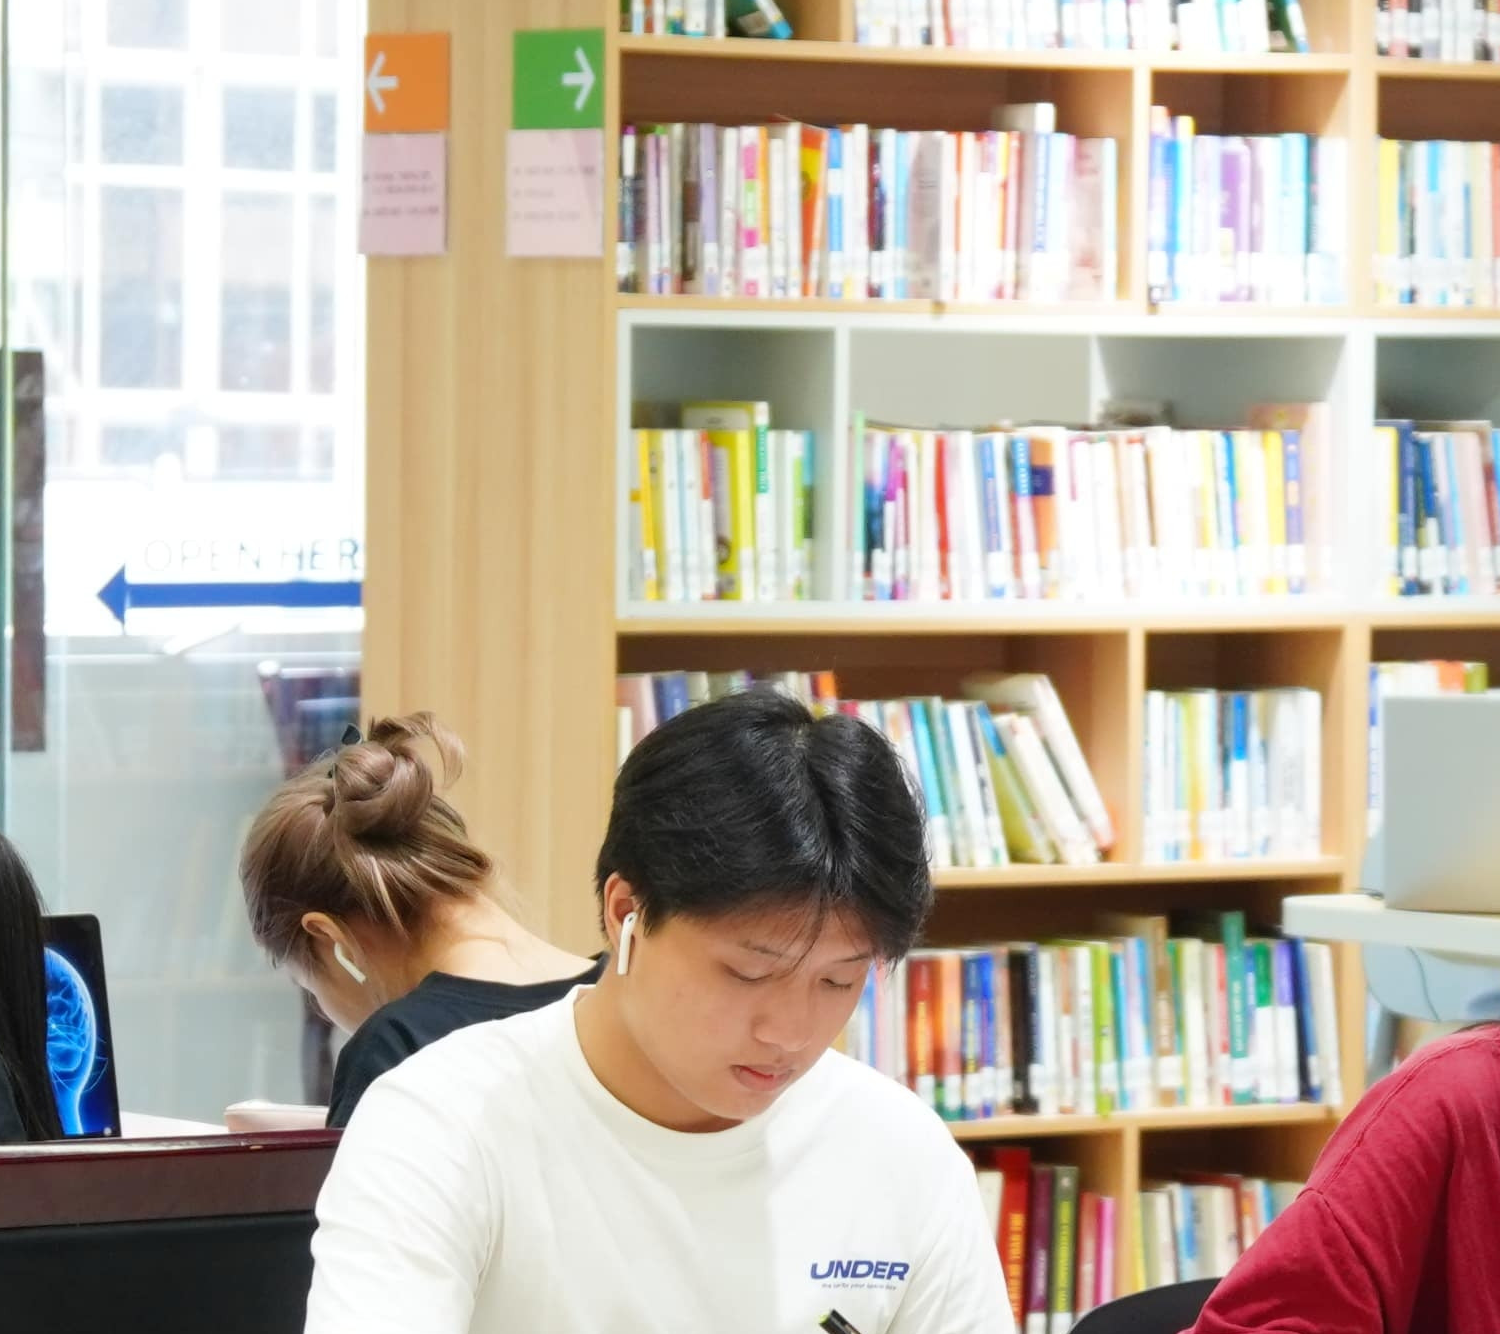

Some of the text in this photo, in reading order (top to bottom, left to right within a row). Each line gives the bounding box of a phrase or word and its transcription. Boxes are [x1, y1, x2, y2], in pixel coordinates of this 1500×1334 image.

[144, 538, 360, 572] OPEN HER
[811, 1260, 910, 1280] UNDER
